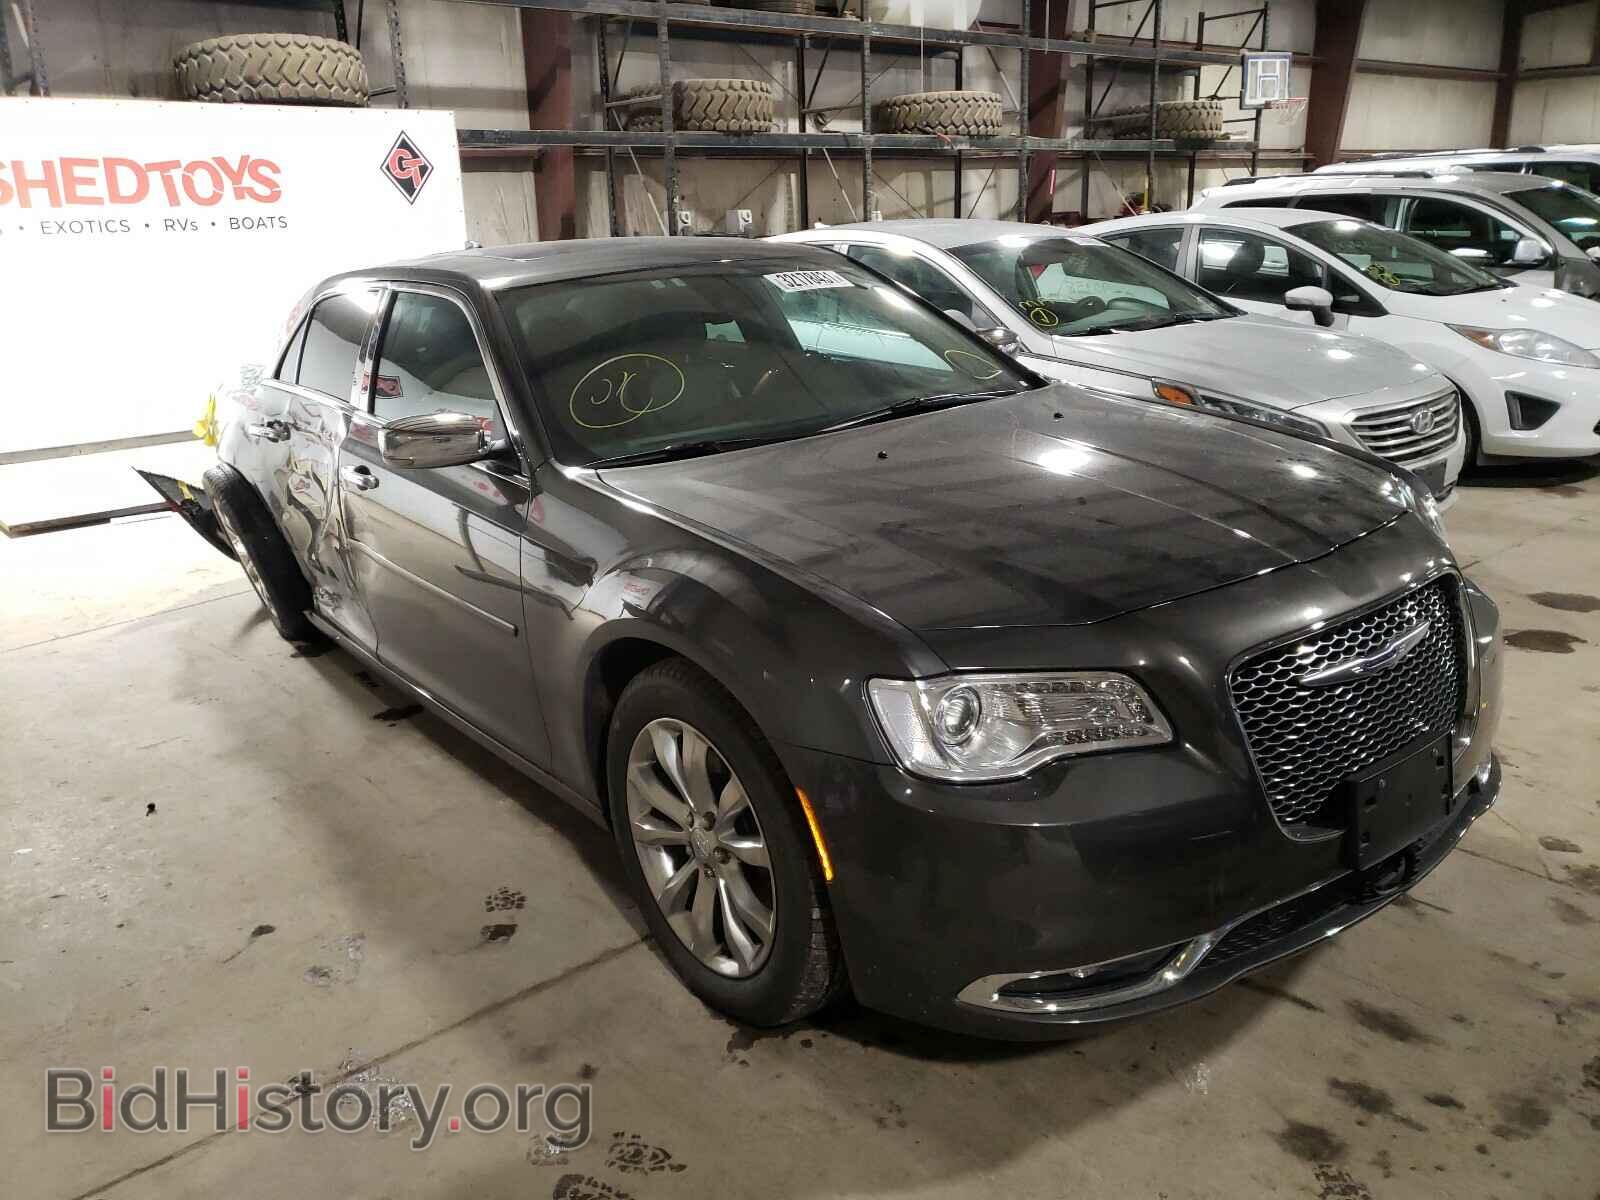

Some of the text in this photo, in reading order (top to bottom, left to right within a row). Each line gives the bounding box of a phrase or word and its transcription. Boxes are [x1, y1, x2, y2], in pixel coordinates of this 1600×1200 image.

[40, 216, 288, 235] EXOTICS RVs BOATS
